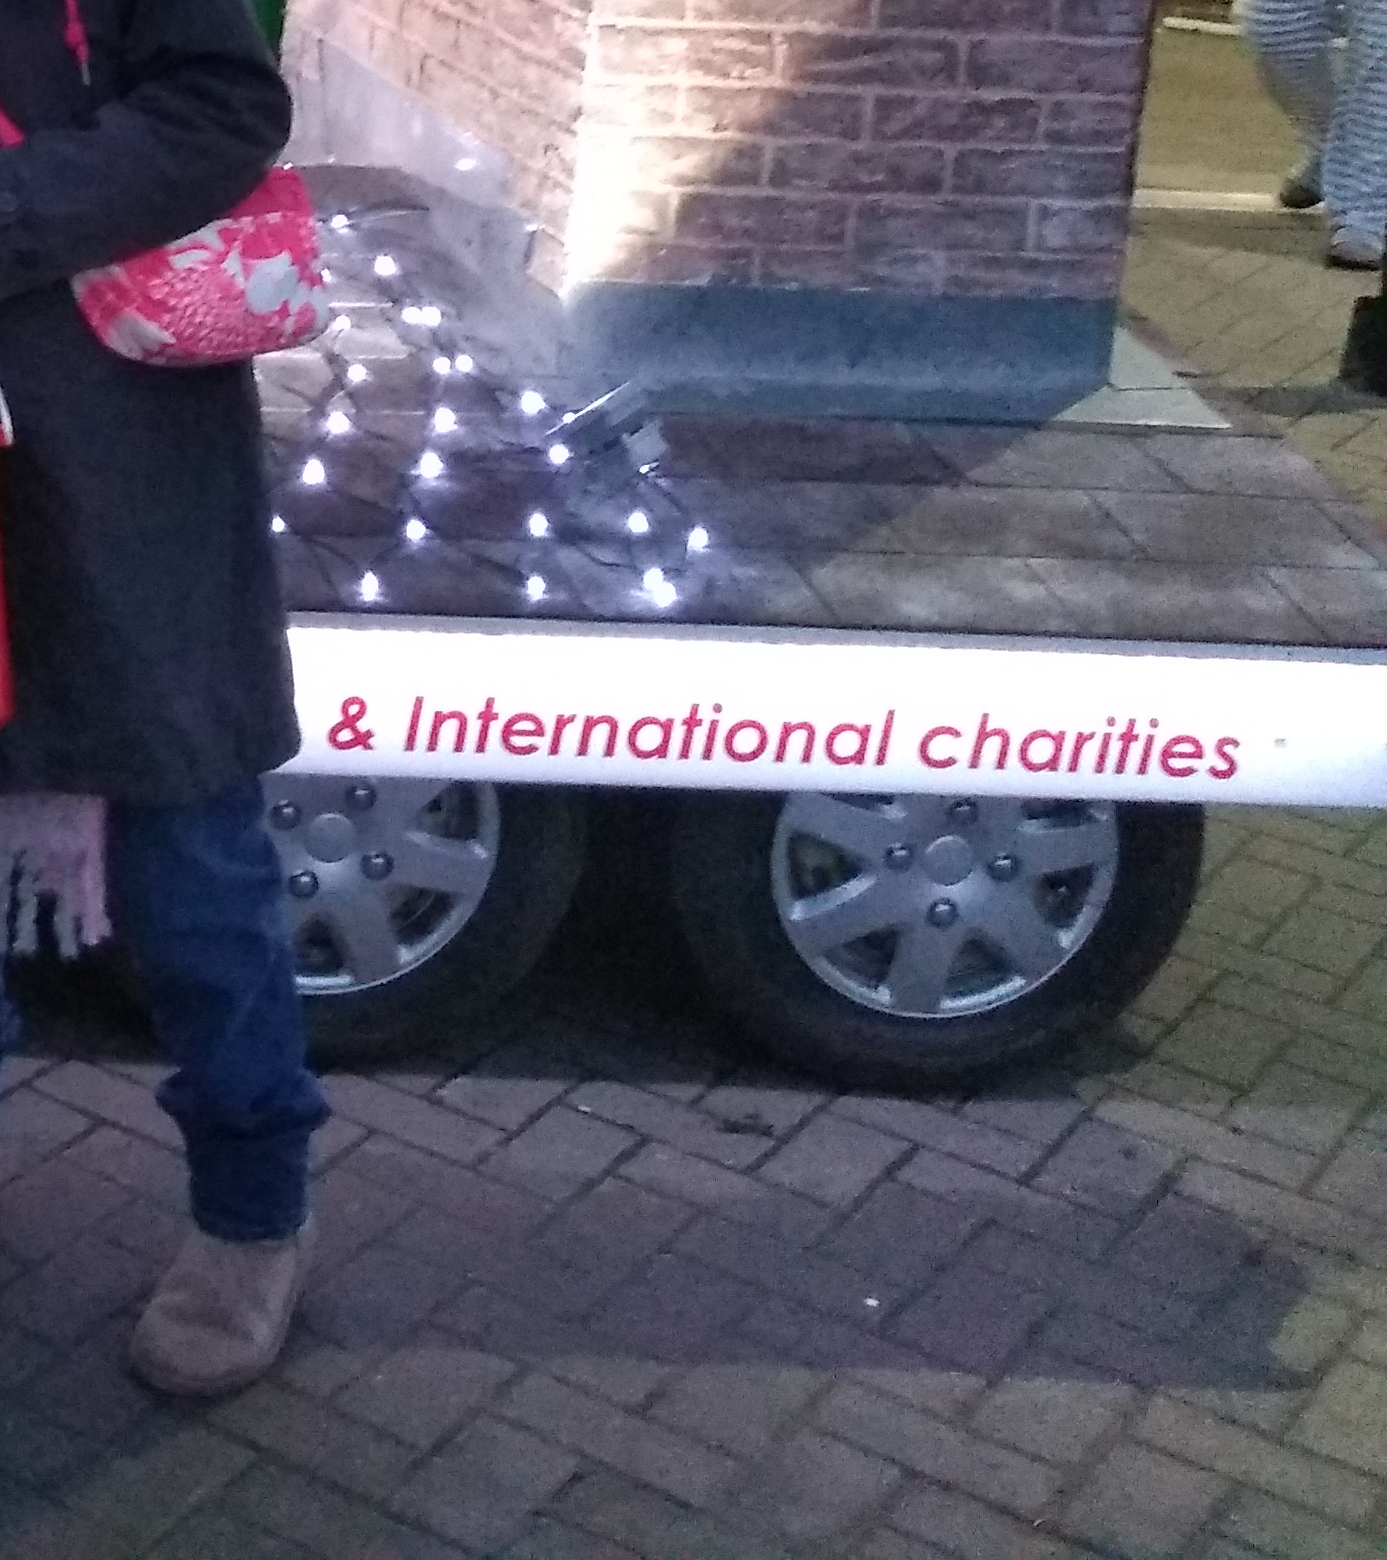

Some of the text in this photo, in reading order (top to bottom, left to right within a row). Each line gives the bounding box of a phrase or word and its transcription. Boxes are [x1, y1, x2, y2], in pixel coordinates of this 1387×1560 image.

[326, 695, 1241, 781] & International charities
